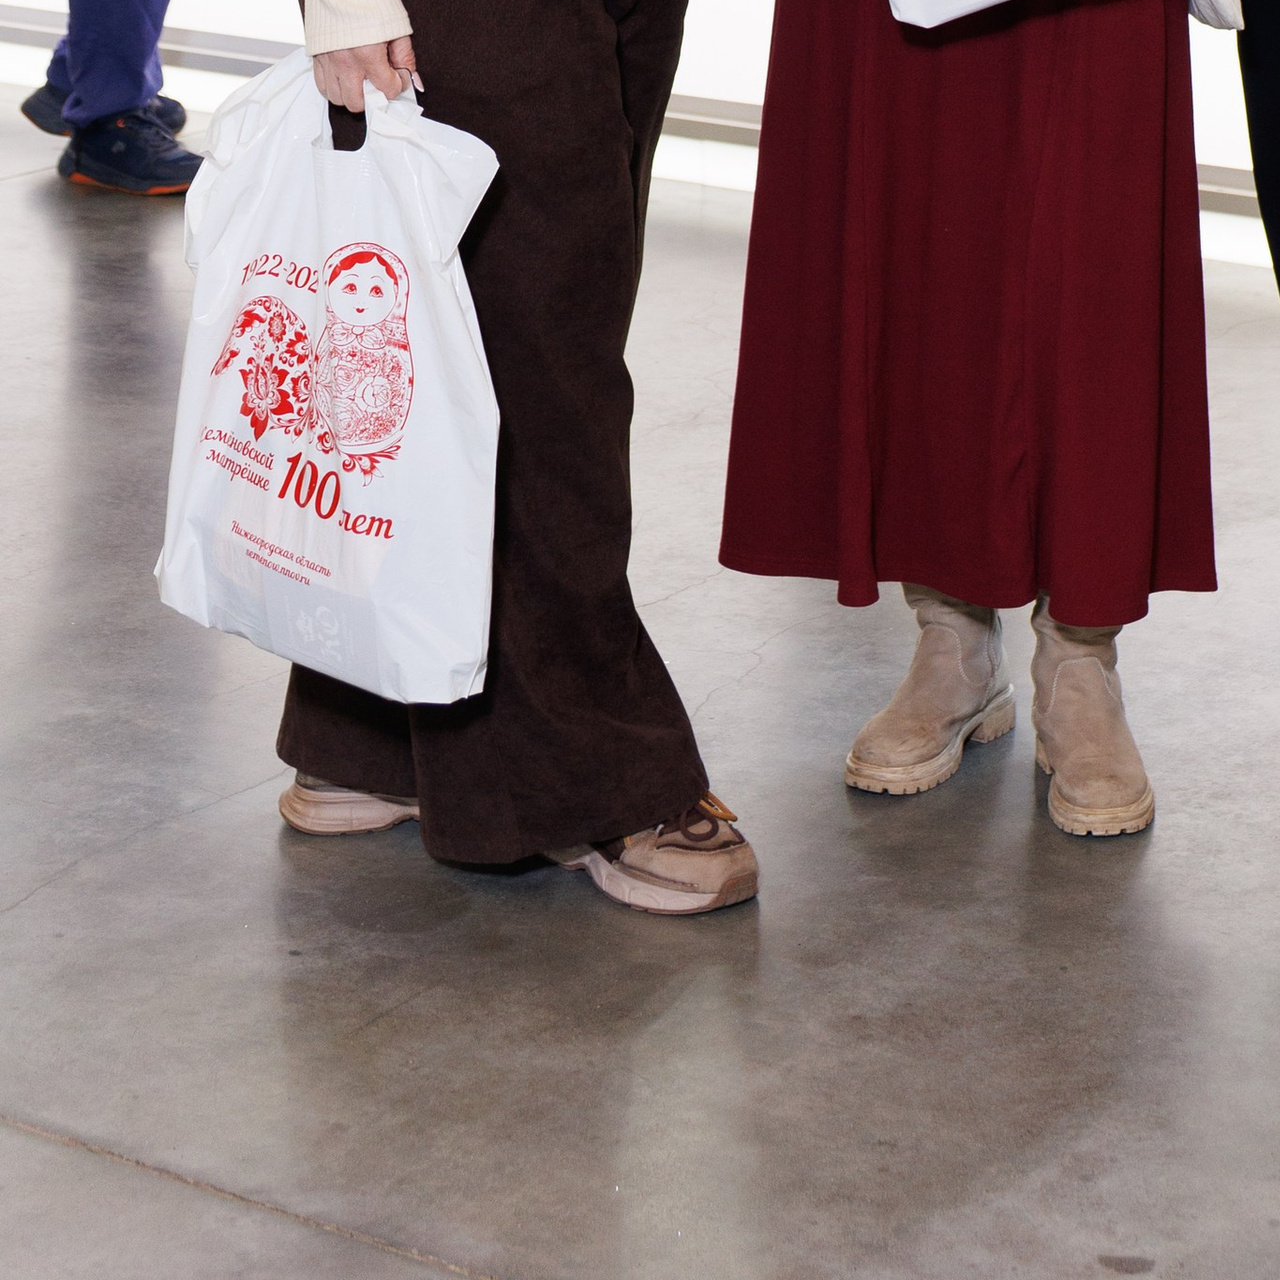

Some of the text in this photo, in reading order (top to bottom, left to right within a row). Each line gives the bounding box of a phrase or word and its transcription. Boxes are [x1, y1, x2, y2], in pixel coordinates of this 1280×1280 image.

[241, 254, 319, 293] 1922-202
[206, 449, 270, 492] матрёшке
[278, 451, 395, 539] 100 лет
[231, 520, 331, 578] Нижегородская область
